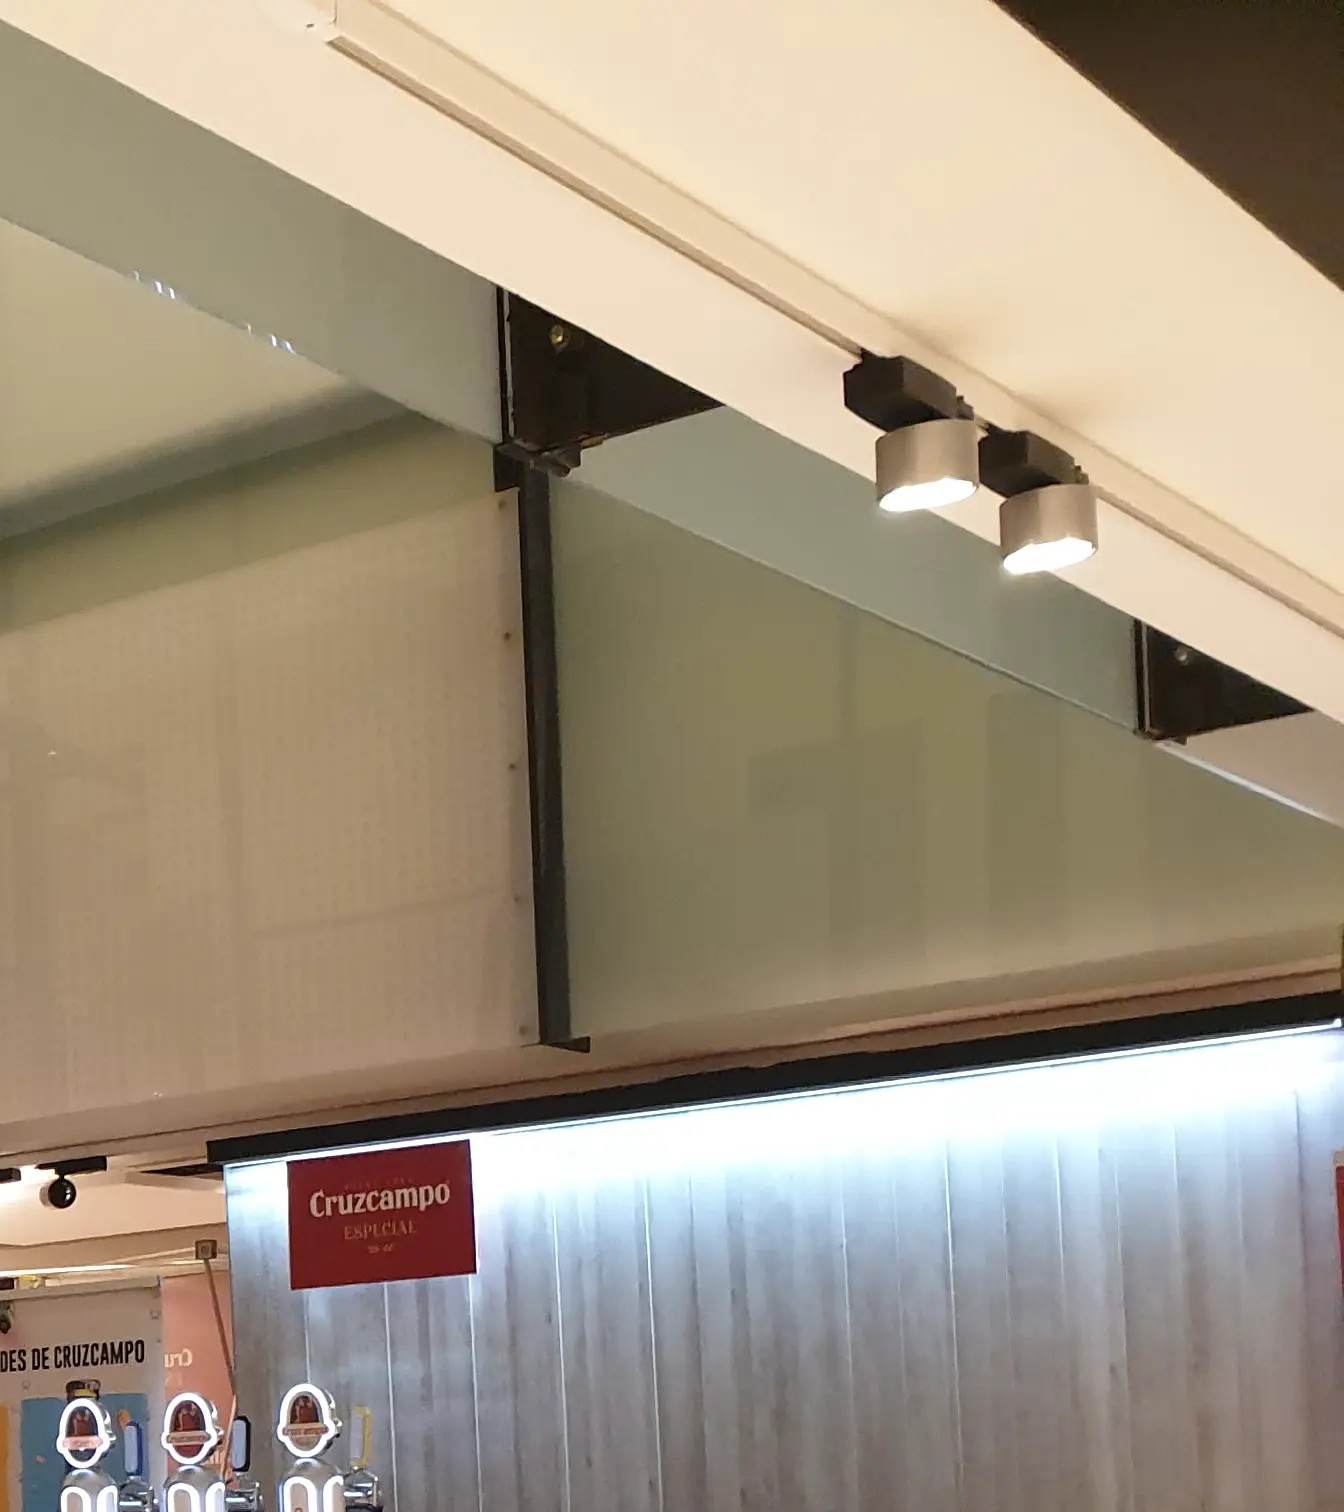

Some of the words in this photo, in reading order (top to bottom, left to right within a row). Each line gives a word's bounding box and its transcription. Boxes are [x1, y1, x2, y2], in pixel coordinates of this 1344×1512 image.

[309, 1182, 451, 1218] Cruzcampo
[343, 1219, 418, 1241] ESPECIAL
[31, 1347, 50, 1371] DE
[54, 1339, 146, 1369] CRUZCAMPO
